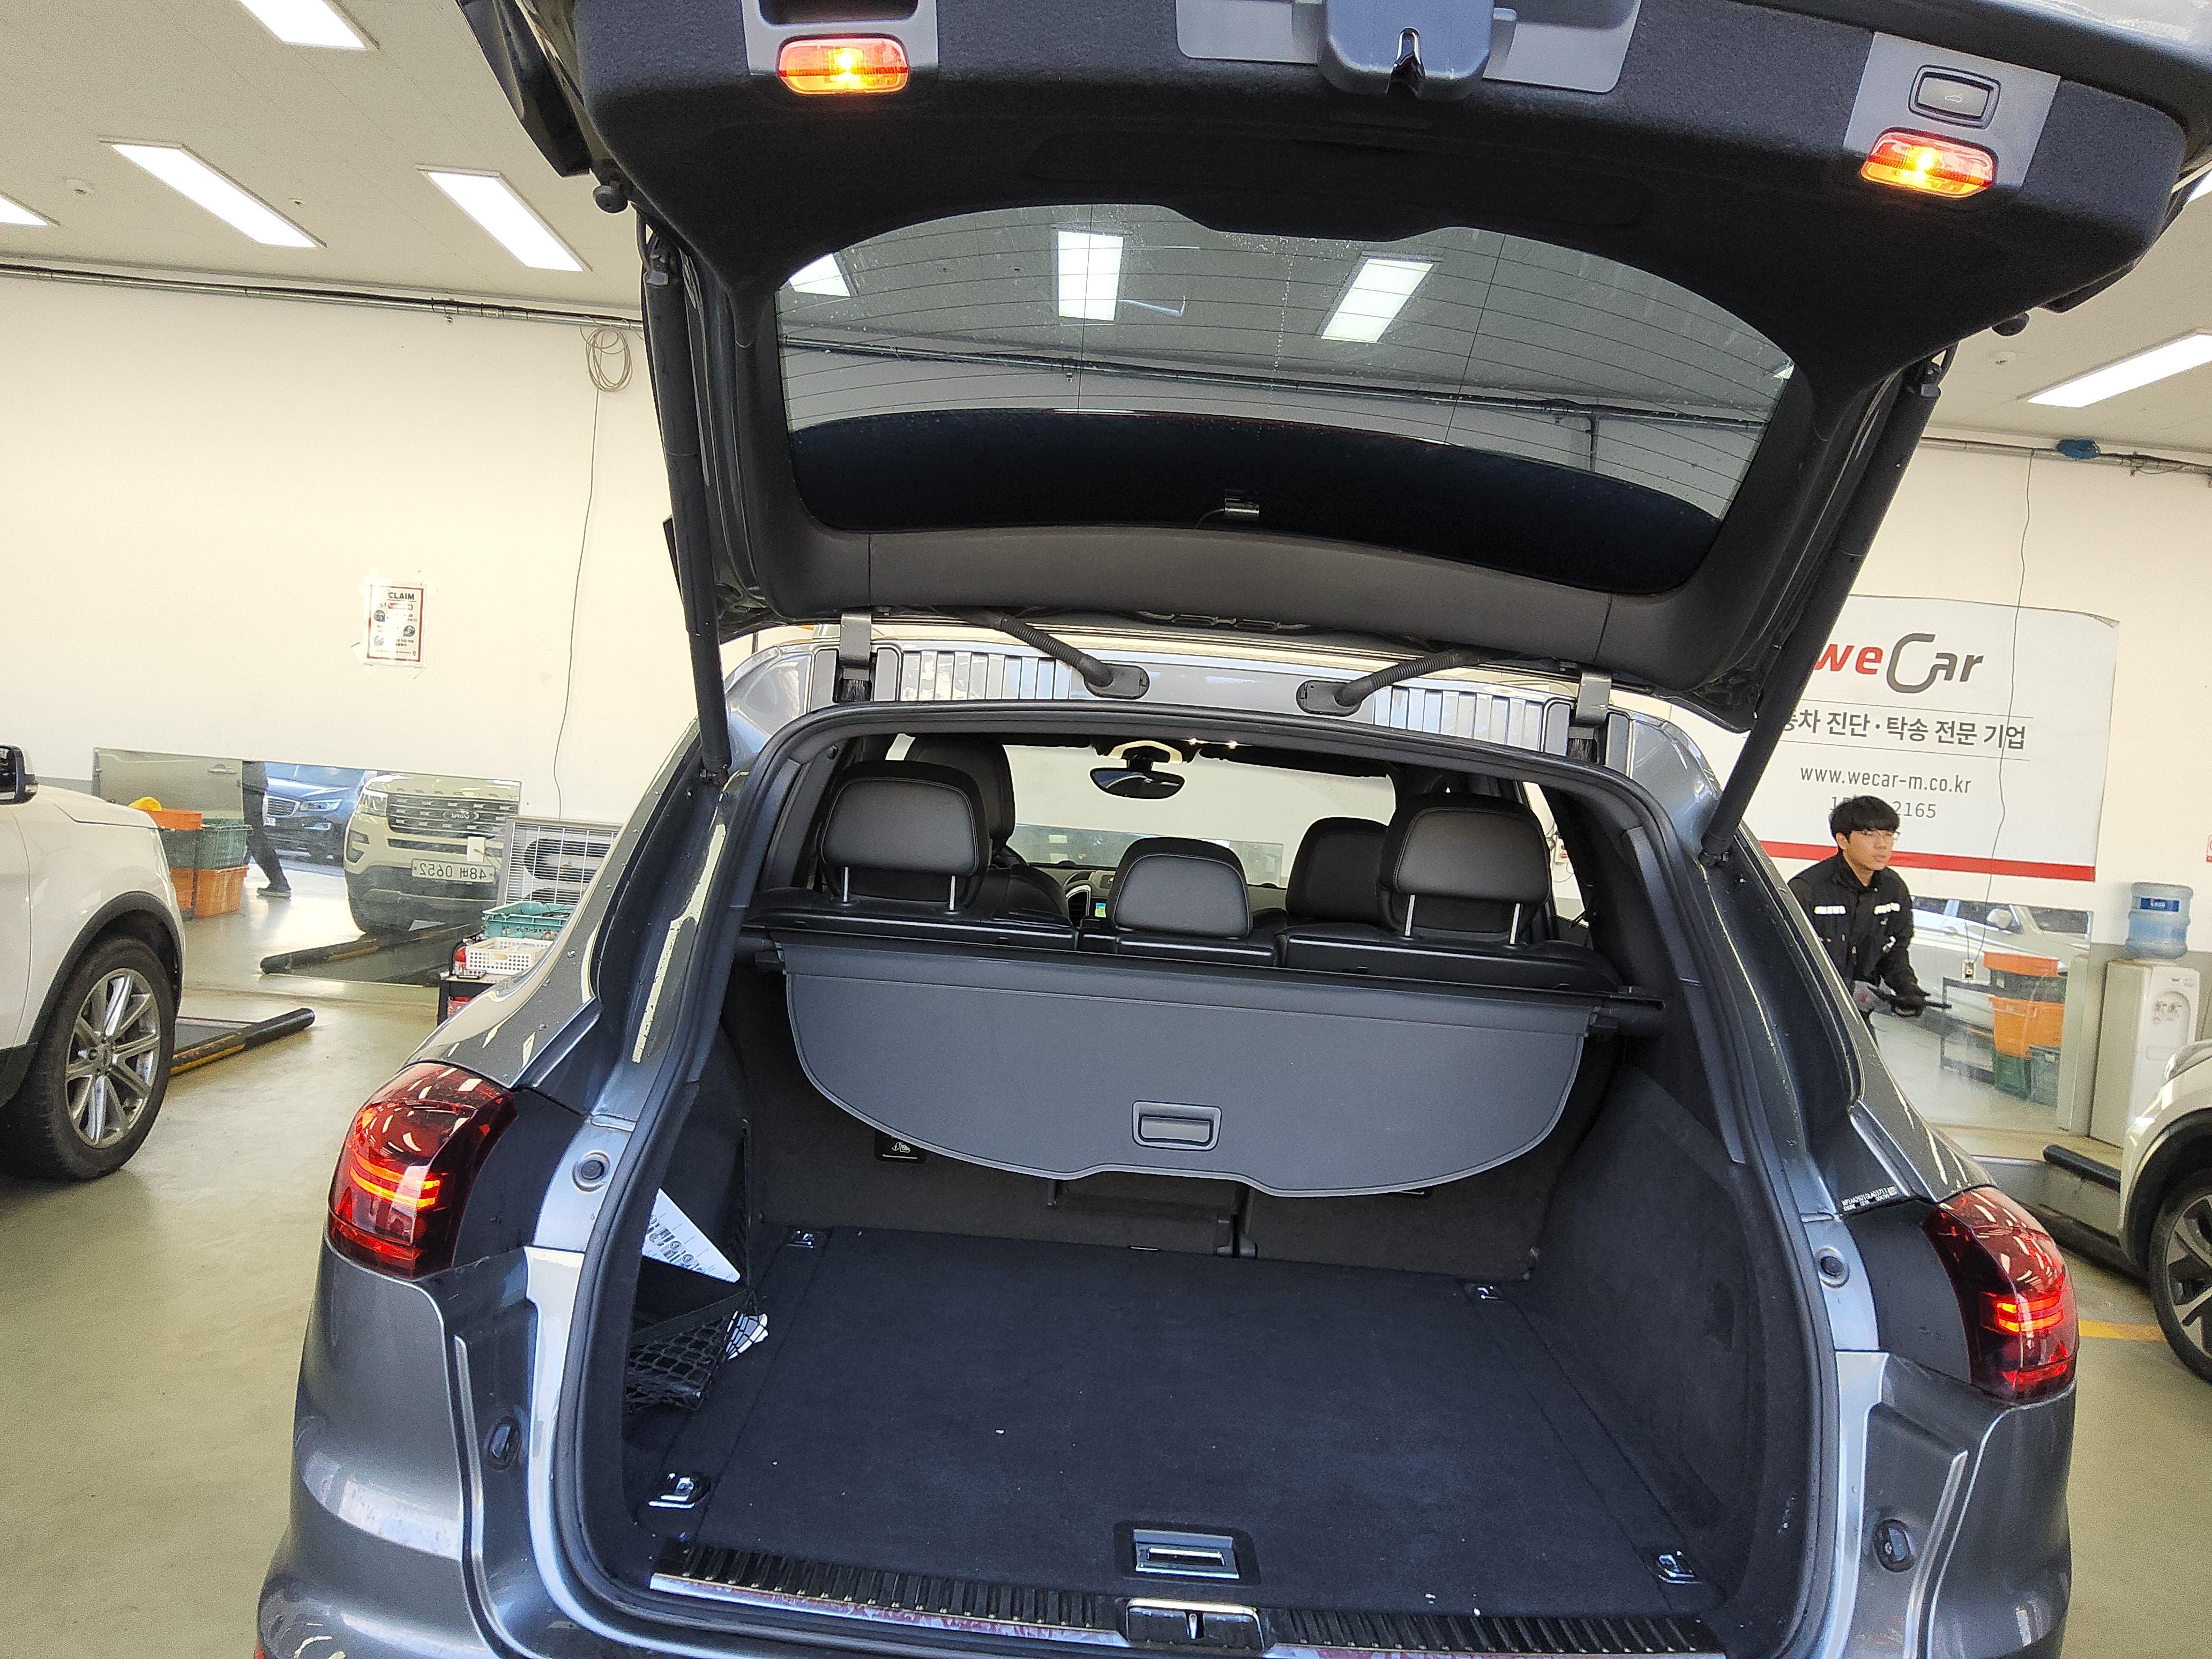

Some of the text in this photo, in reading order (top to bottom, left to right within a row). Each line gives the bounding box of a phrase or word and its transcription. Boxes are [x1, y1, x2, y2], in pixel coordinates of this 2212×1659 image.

[388, 592, 415, 600] CLAIM
[1935, 721, 1977, 746] 전문
[1984, 724, 2026, 750] 기업
[1800, 767, 1972, 794] www.wecar-m.co.kr
